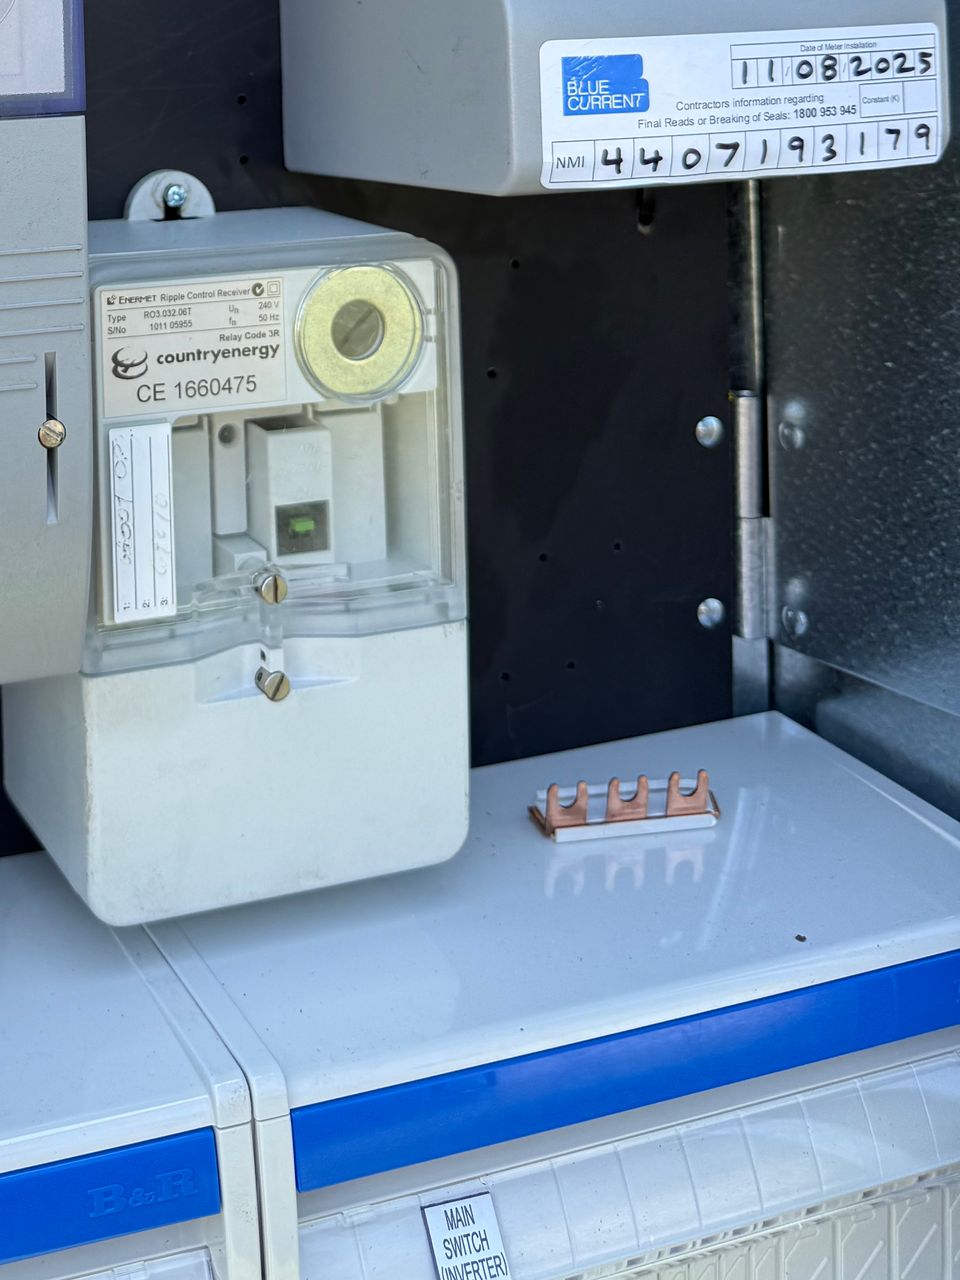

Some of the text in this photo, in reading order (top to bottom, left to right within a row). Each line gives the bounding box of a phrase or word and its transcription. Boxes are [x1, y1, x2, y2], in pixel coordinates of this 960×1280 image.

[567, 79, 609, 96] BLUE
[567, 92, 645, 112] CURRENT
[675, 93, 824, 111] Contractors information regarding
[638, 105, 857, 129] Final Reads or Breaking of Seals: 1800 953 945
[555, 155, 584, 169] NMI
[160, 288, 251, 303] Ripple Control Receiver
[107, 314, 126, 324] Type
[258, 301, 272, 310] 240
[107, 326, 126, 335] S/No
[150, 322, 167, 331] 1011
[258, 313, 268, 322] 50
[270, 312, 280, 321] Hz
[219, 329, 280, 343] Relay Code 3R
[156, 344, 280, 364] countryenergy
[137, 374, 256, 403] CE 1660475
[444, 1204, 475, 1231] MAIN
[443, 1229, 490, 1260] SWITCH
